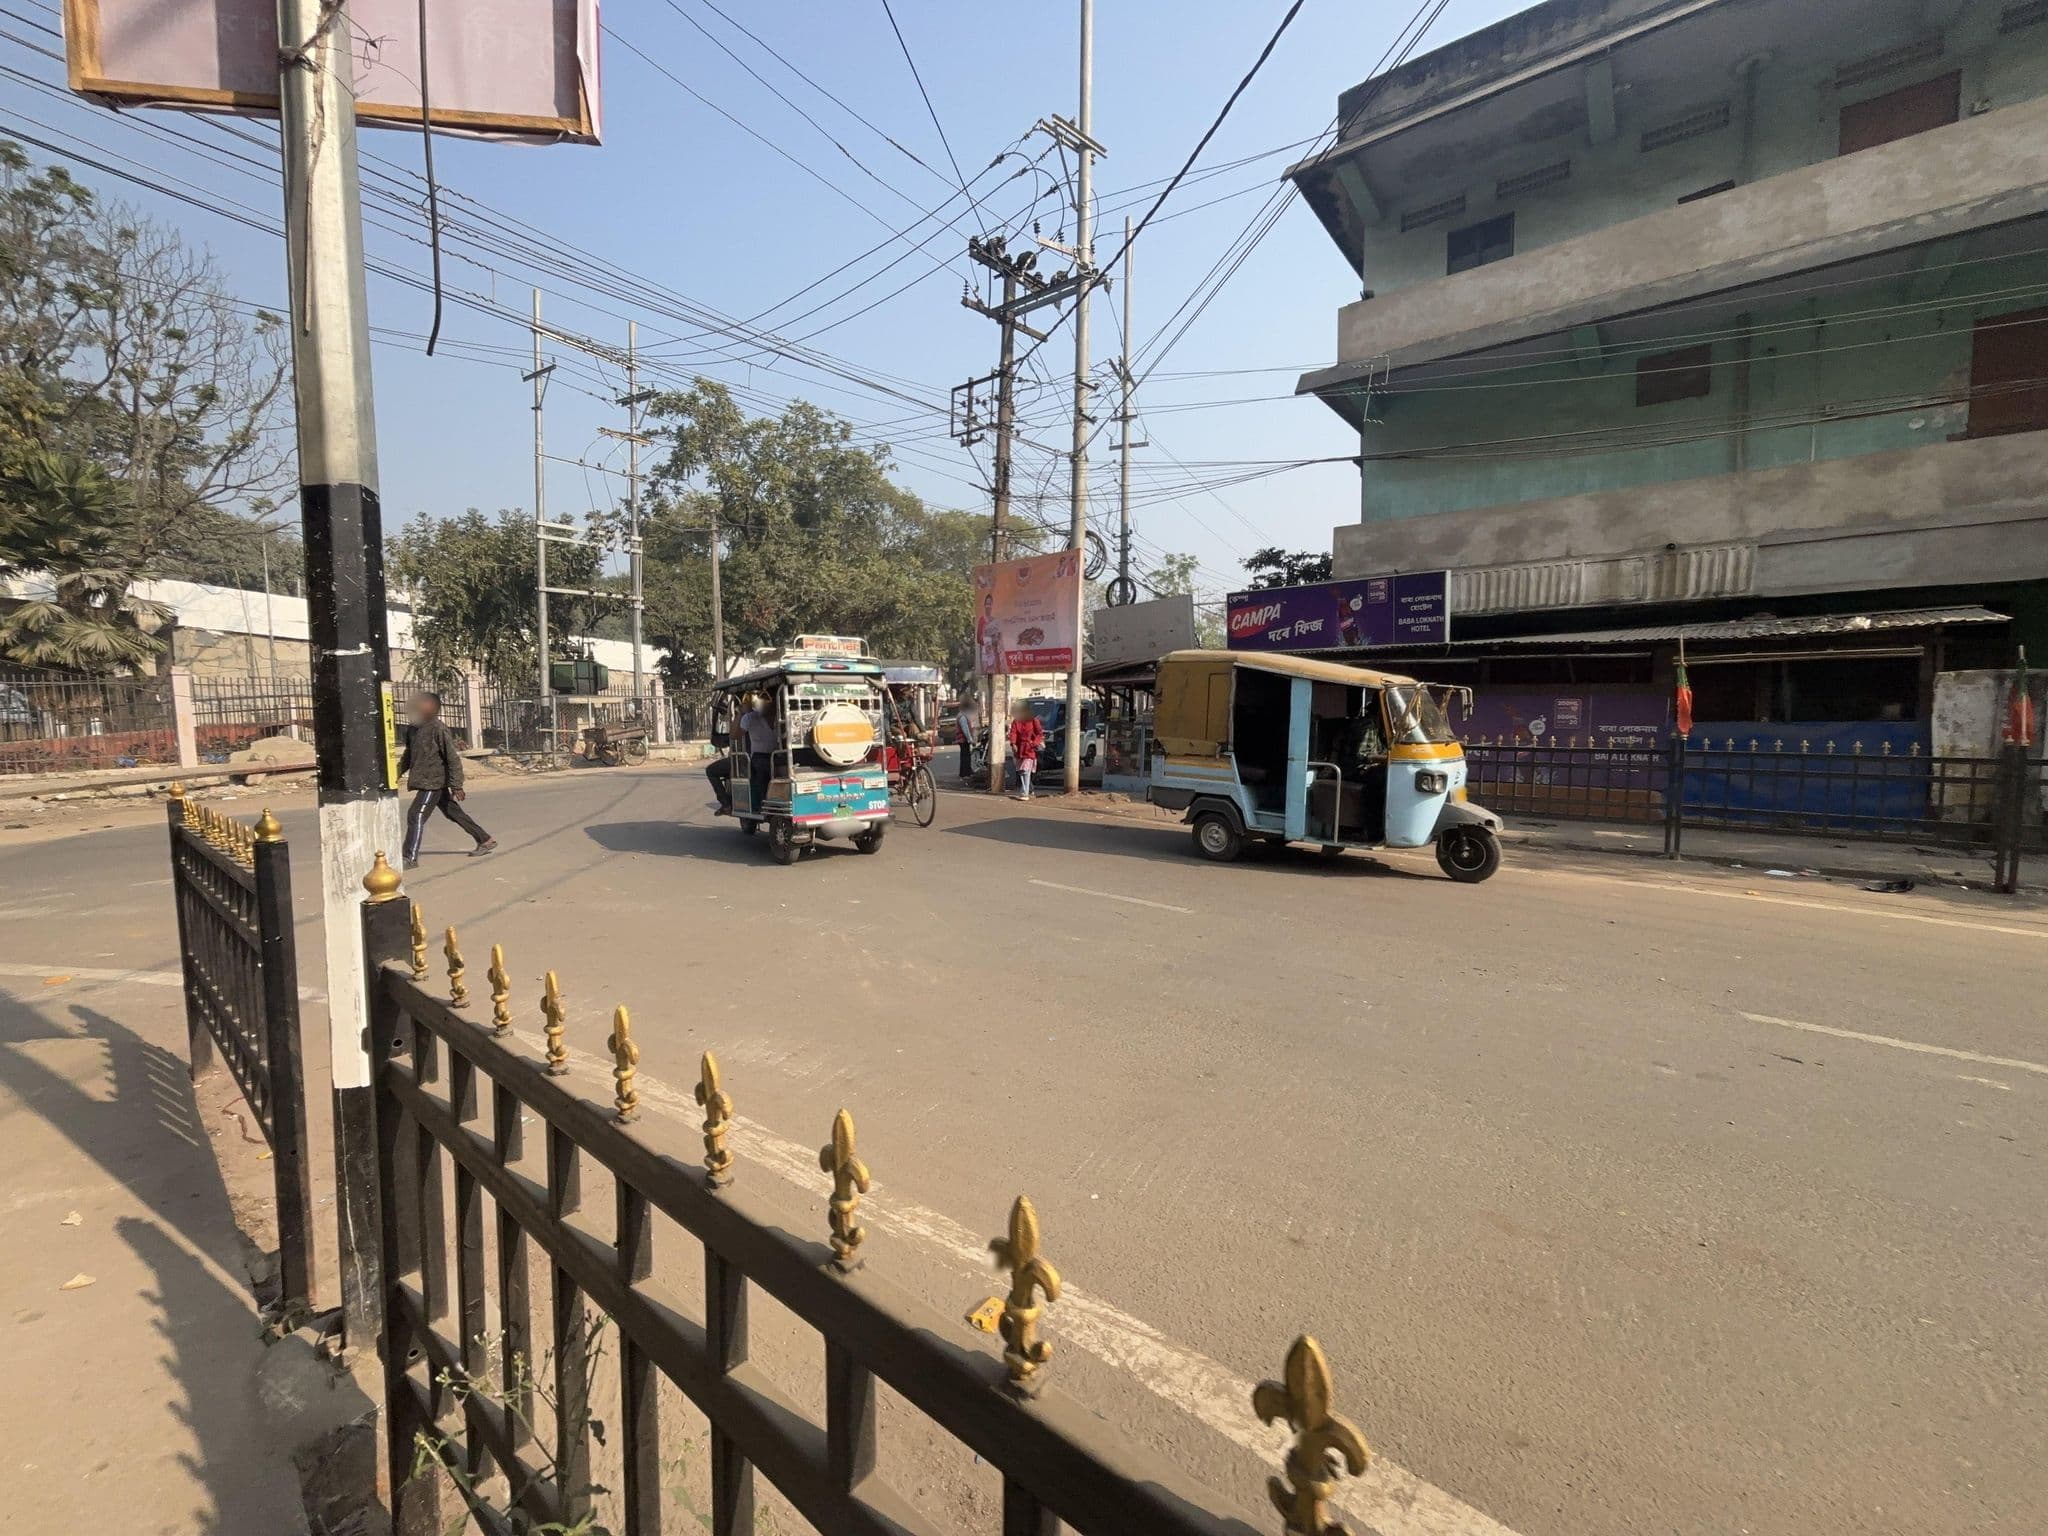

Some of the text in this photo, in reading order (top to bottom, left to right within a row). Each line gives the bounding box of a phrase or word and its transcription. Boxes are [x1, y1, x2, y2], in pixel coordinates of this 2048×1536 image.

[1232, 603, 1281, 631] CAMPA
[1398, 615, 1445, 625] BABA LOKNATH
[868, 800, 887, 810] STOP
